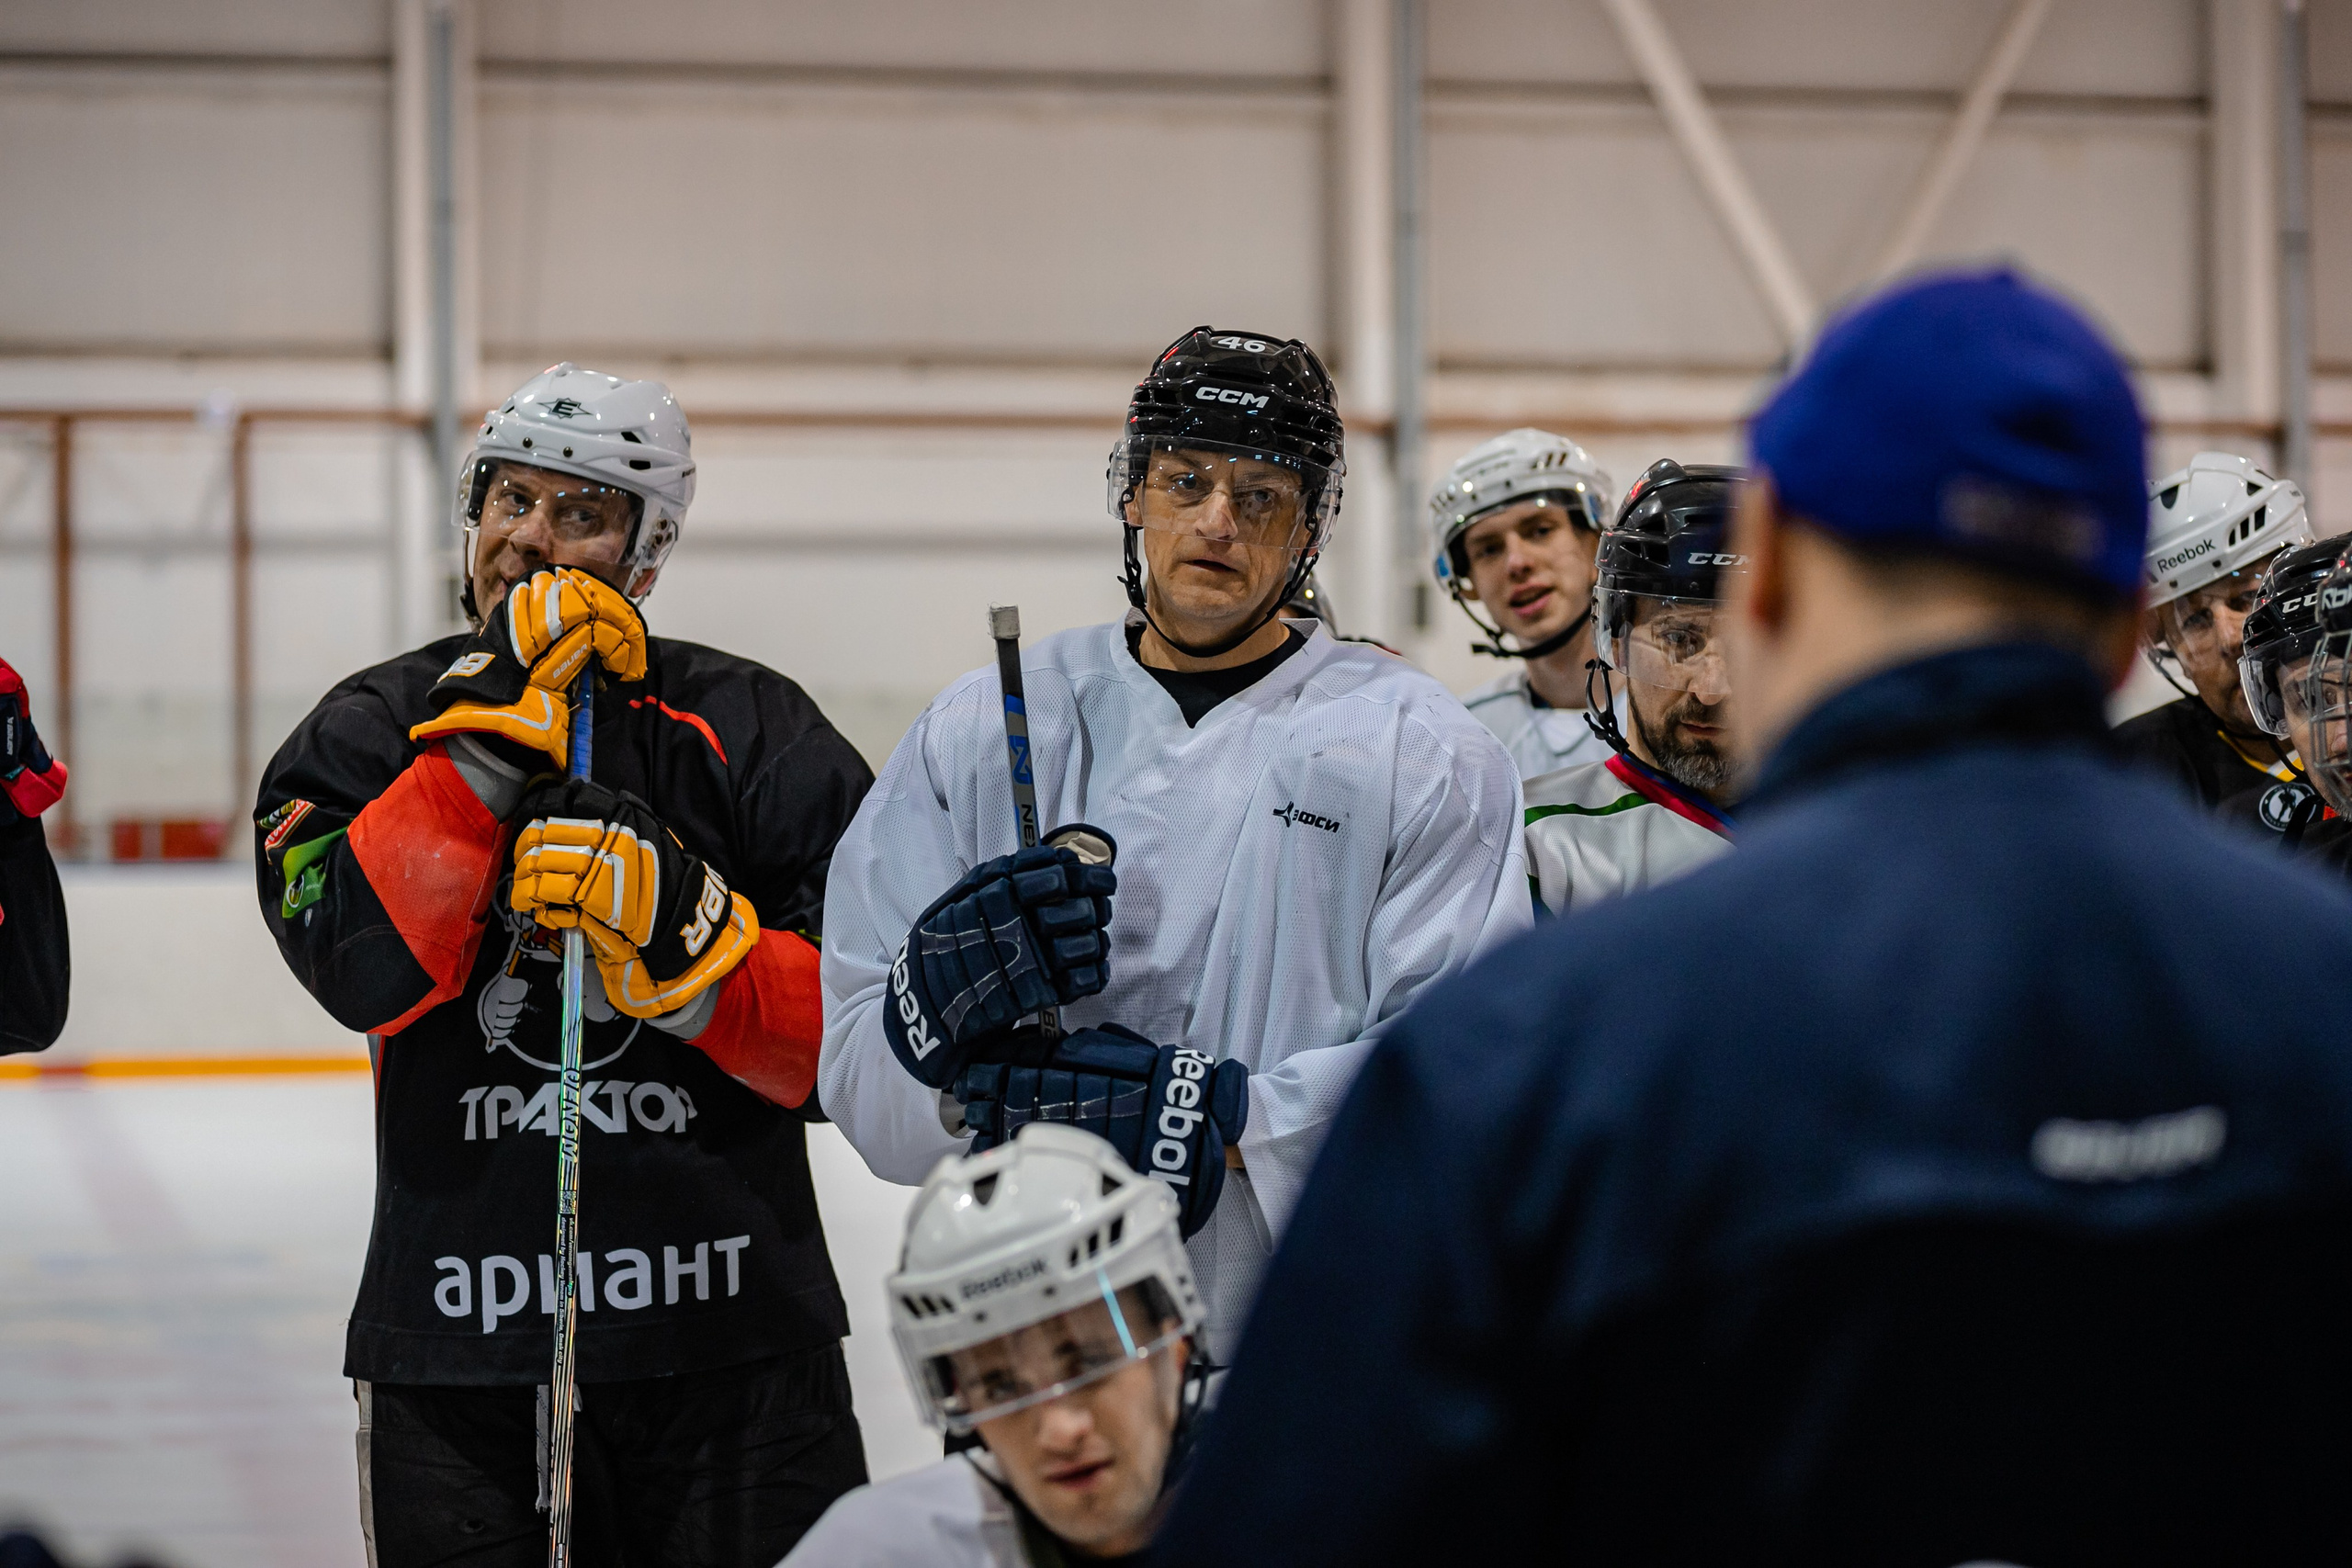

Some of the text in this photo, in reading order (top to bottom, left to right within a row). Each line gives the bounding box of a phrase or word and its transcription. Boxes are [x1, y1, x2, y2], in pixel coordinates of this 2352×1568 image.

[1217, 336, 1267, 353] 46
[1195, 386, 1270, 408] CCM
[2156, 538, 2216, 574] Reebok
[2282, 592, 2318, 614] CC
[552, 643, 588, 680] BAUER
[892, 926, 941, 1062] Reeb
[458, 1079, 698, 1141] ТРАКТОР
[434, 1235, 751, 1334] ариант
[558, 1256, 566, 1280] Hockey
